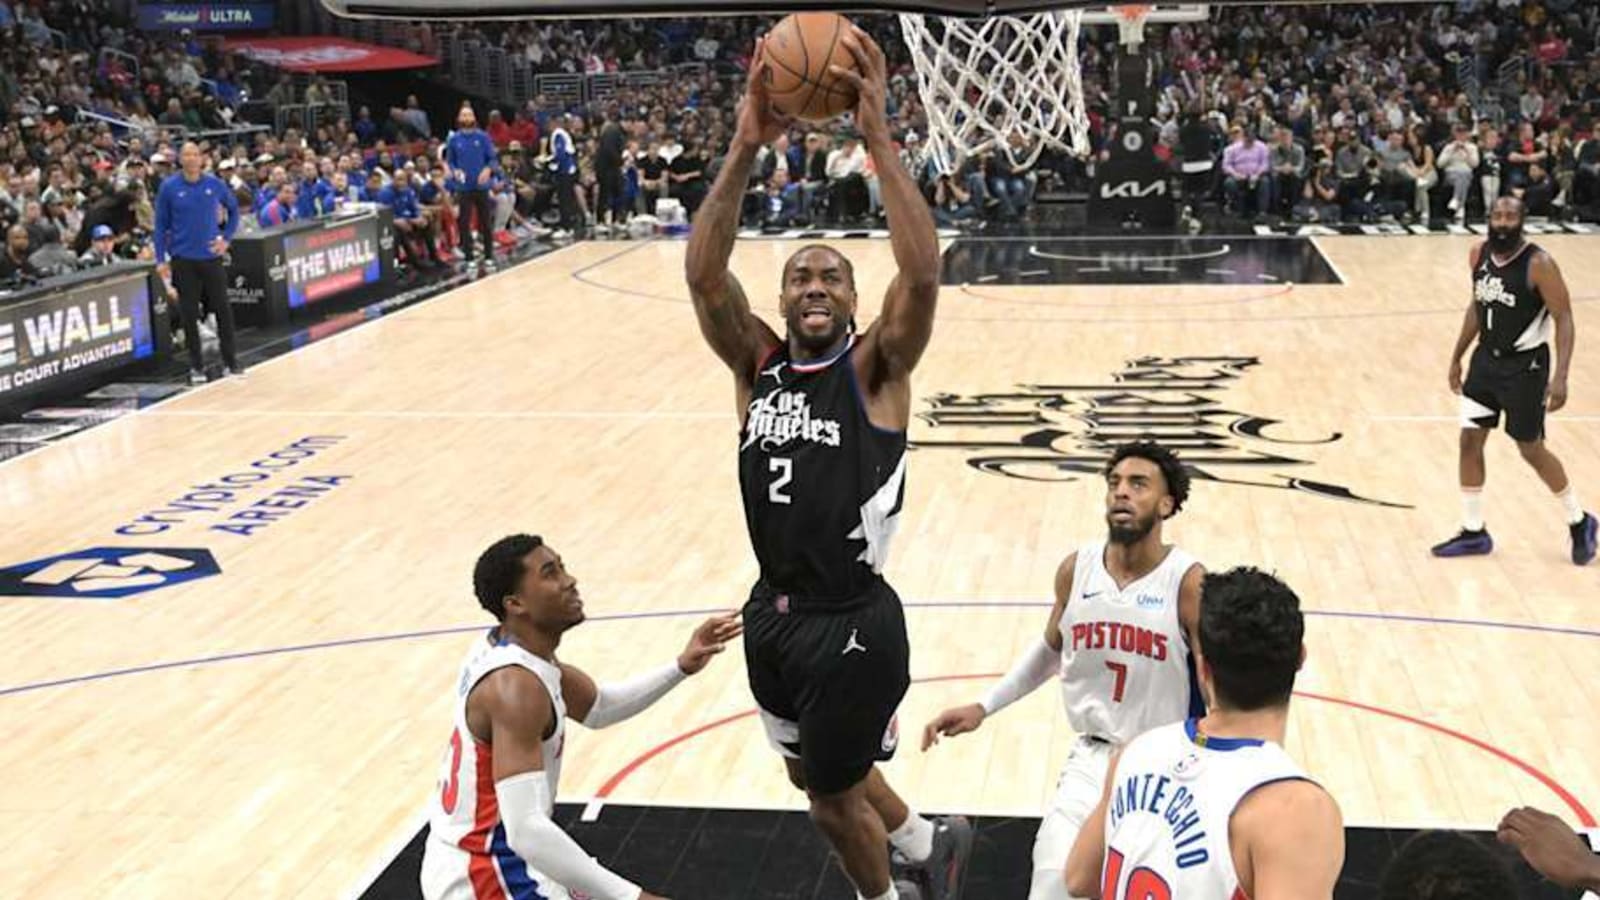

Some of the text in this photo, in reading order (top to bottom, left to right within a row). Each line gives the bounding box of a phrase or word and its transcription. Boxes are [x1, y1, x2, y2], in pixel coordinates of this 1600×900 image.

[209, 9, 253, 23] ULTRA
[288, 252, 326, 283] THE
[328, 239, 375, 272] WALL
[24, 295, 131, 357] WALL
[1487, 308, 1493, 330] 1
[14, 359, 60, 387] COURT
[62, 338, 133, 372] ADVANTAGE
[741, 398, 841, 453] Angeles
[115, 434, 347, 536] crypto.com
[768, 457, 793, 504] 2
[209, 474, 353, 537] ARENA
[1072, 621, 1168, 662] PISTONS
[1105, 660, 1128, 703] 7
[1110, 772, 1210, 870] FONTECCHIO
